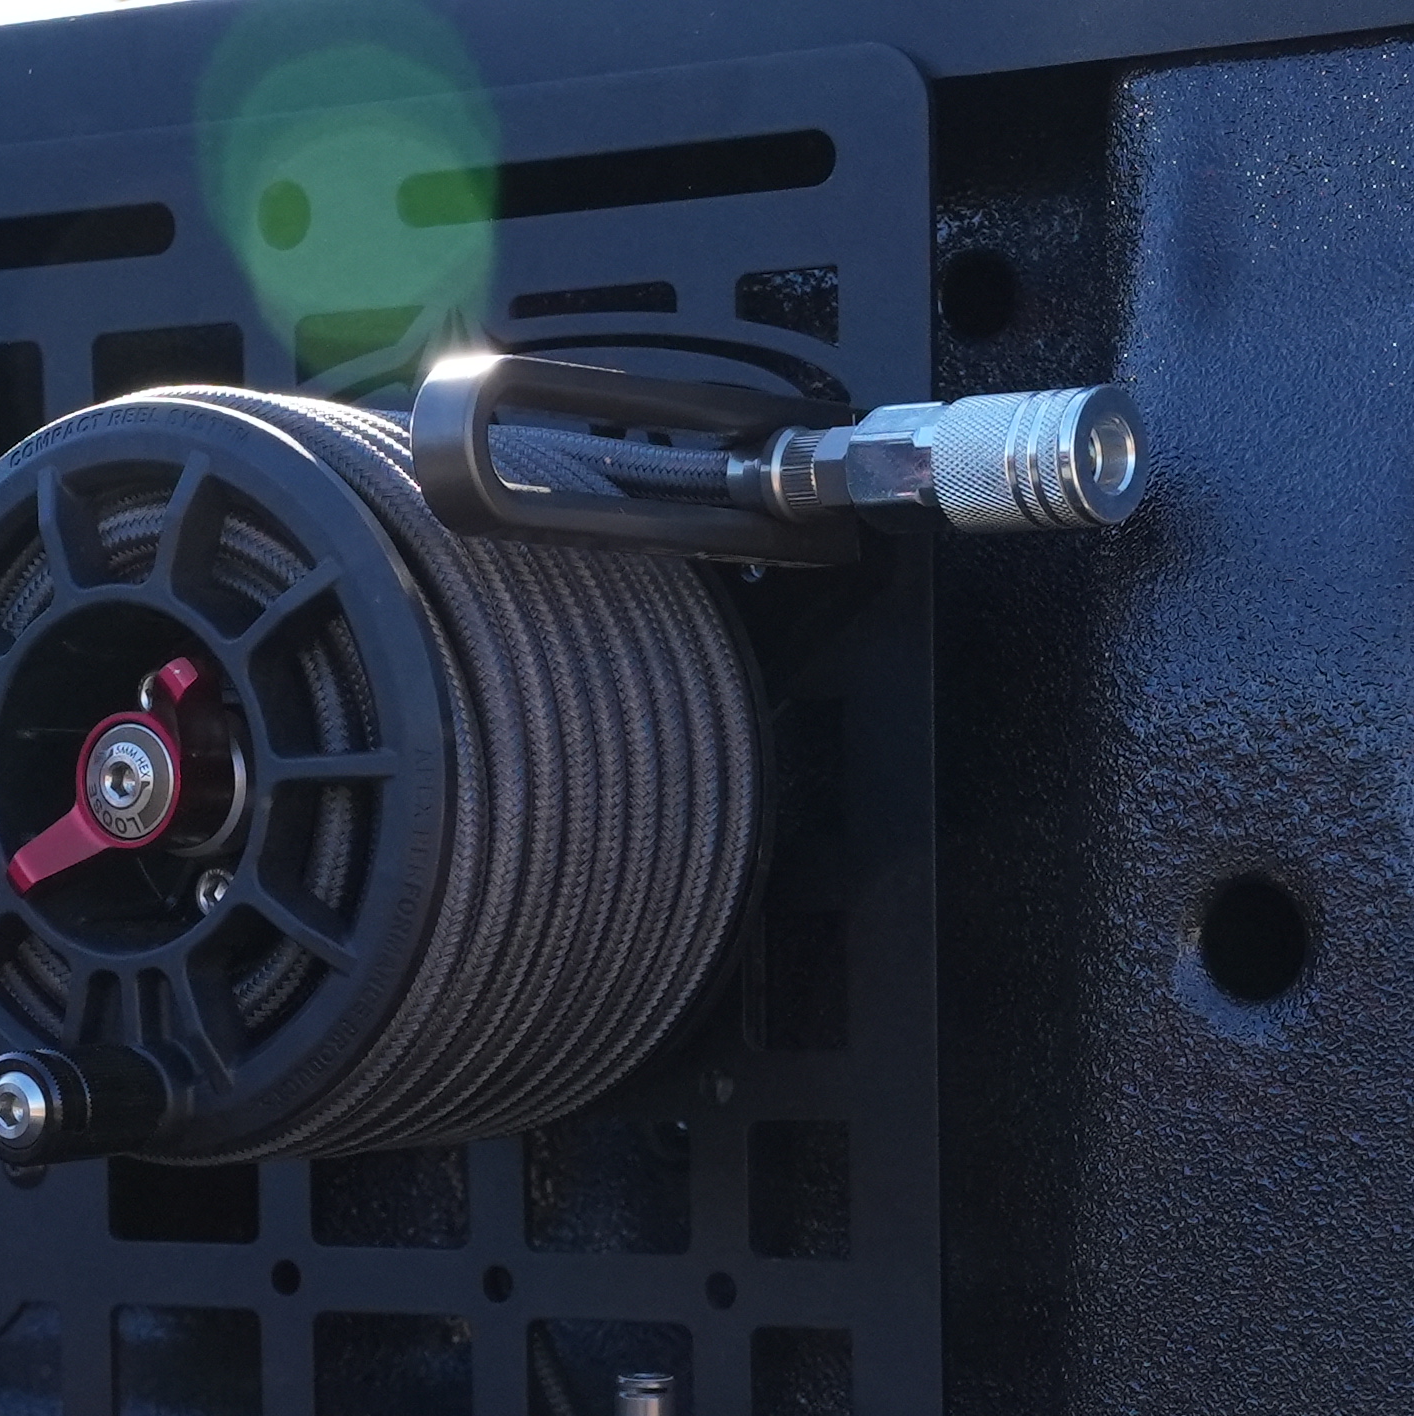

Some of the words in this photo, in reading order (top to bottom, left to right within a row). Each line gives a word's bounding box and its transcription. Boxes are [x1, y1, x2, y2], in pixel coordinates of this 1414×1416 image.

[10, 411, 104, 468] COMPACT
[107, 406, 160, 428] REEL
[137, 756, 151, 780] HEX
[88, 783, 142, 834] LOOSE
